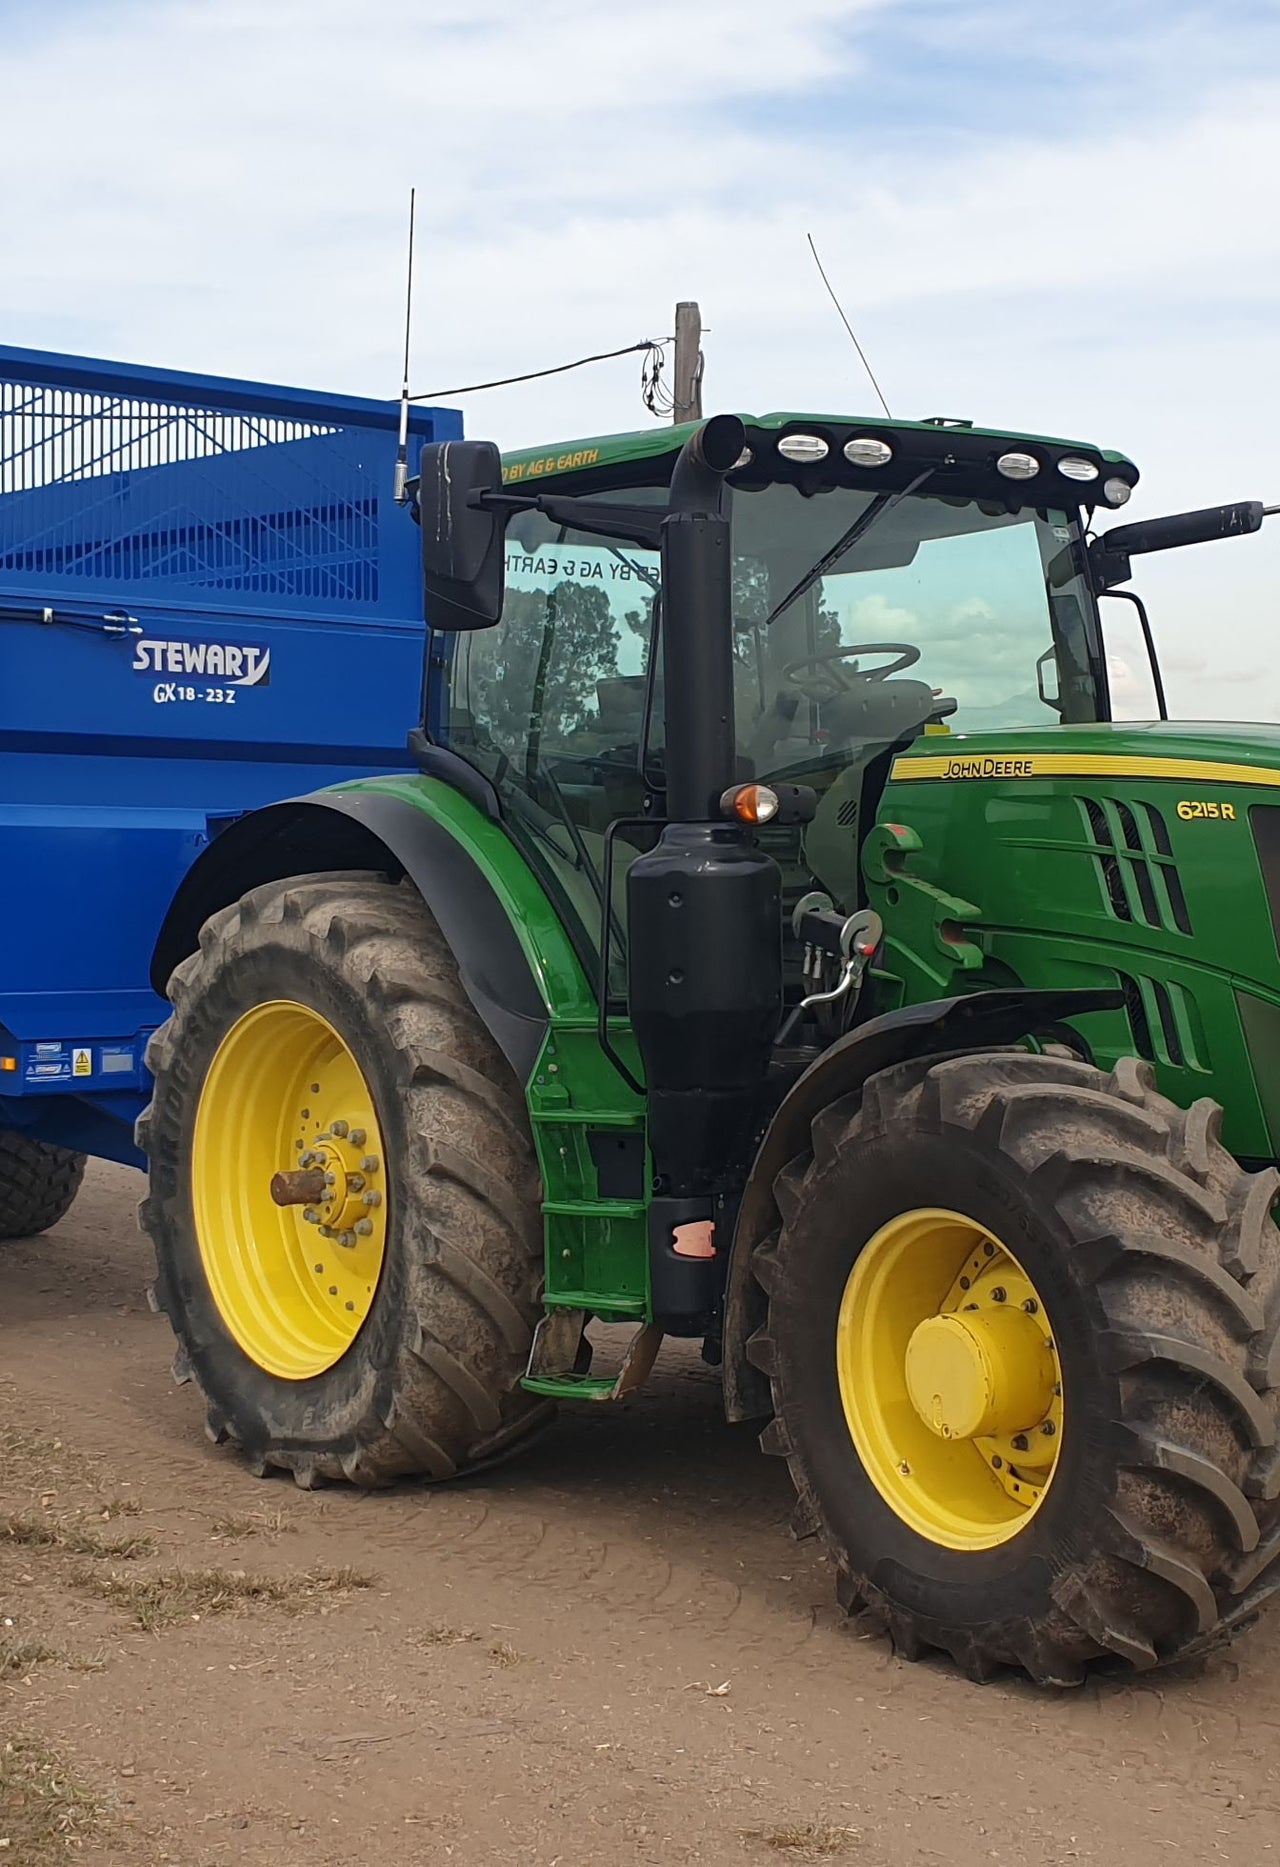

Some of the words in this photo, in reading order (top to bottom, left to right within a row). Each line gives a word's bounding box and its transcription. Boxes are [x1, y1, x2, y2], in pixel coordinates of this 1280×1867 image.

[509, 464, 526, 480] BY
[526, 460, 545, 477] AG
[557, 449, 599, 470] EARTH
[132, 639, 270, 686] STEWART
[153, 682, 176, 704] GX
[943, 760, 981, 777] JOHN
[983, 759, 1033, 775] DEERE
